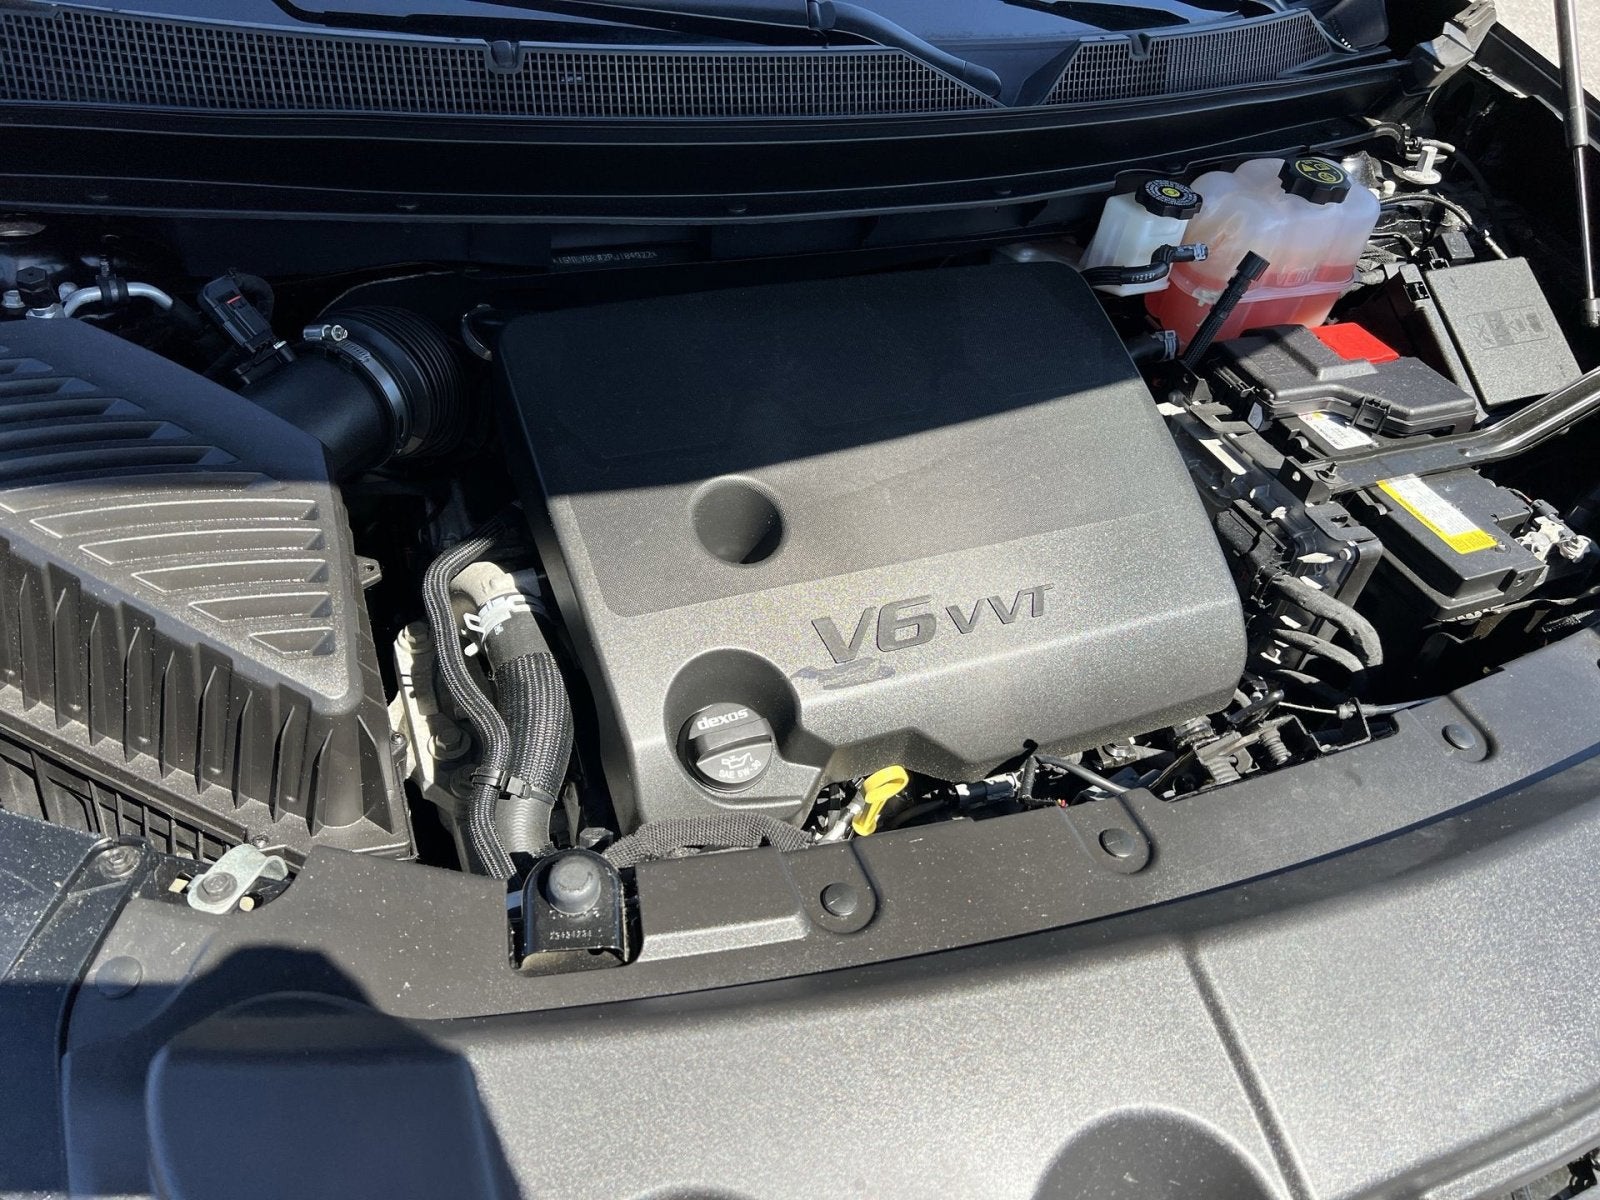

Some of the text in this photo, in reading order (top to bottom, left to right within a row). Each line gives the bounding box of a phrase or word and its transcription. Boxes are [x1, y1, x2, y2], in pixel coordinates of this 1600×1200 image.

[811, 584, 1054, 664] V6 VVT
[697, 708, 749, 730] dexos
[719, 769, 735, 779] SAE
